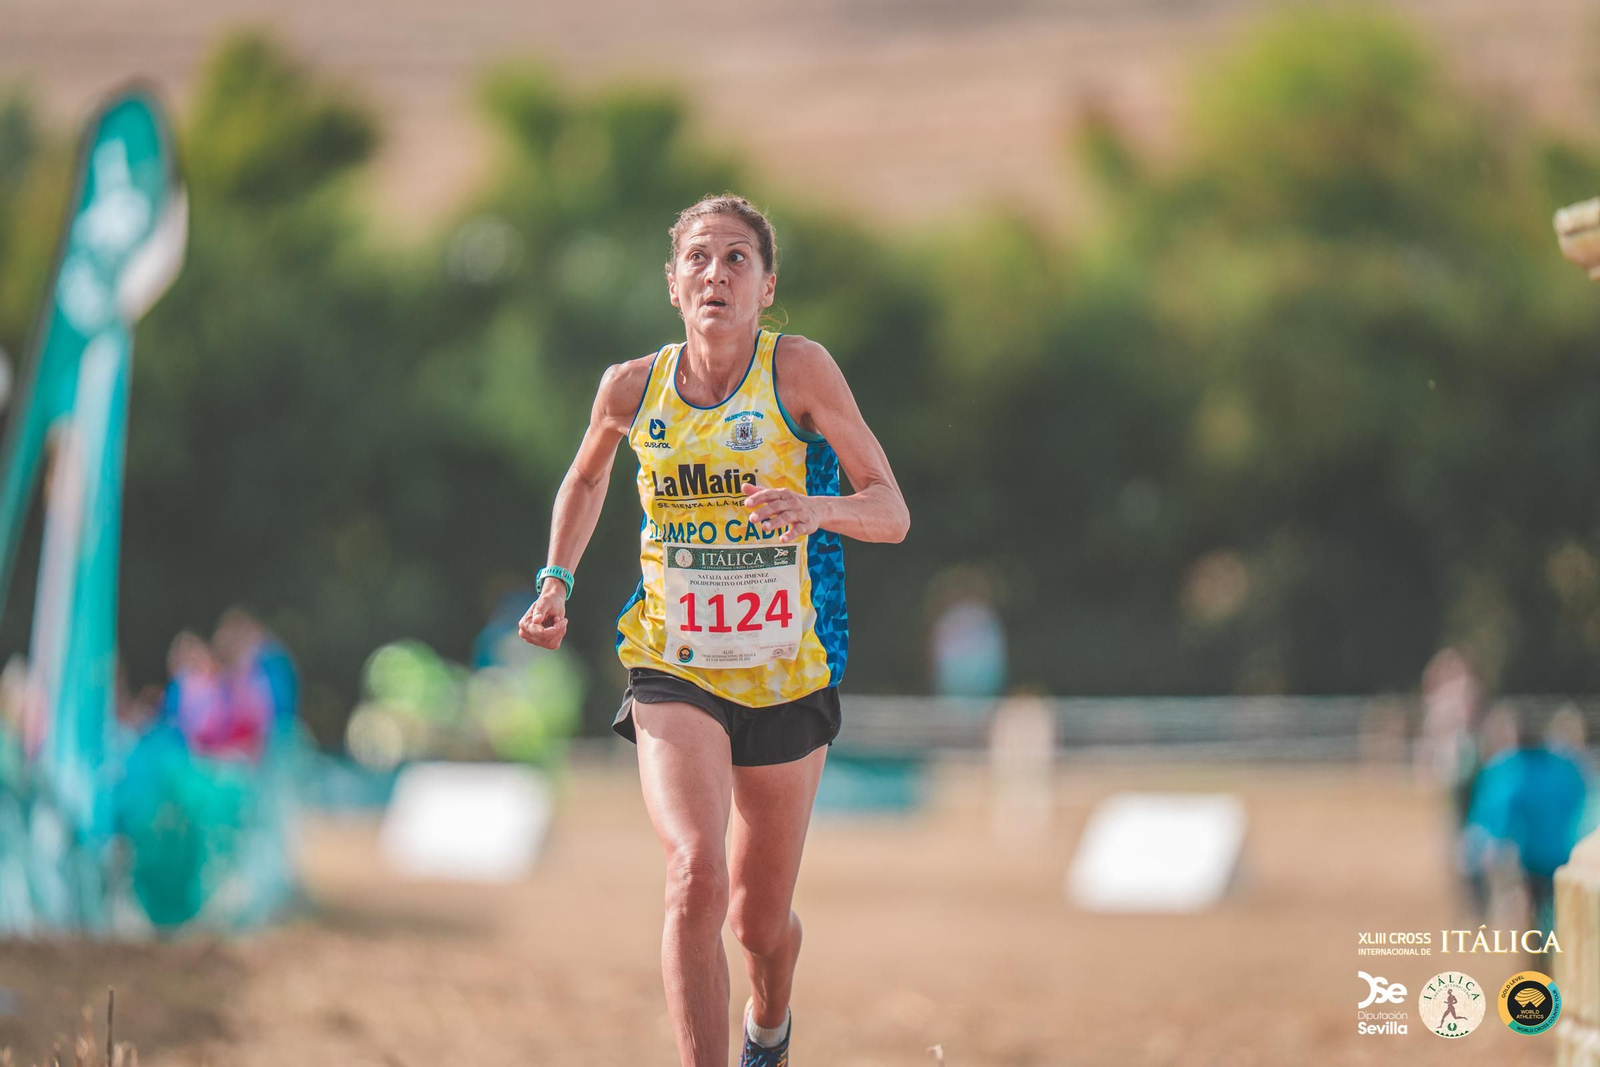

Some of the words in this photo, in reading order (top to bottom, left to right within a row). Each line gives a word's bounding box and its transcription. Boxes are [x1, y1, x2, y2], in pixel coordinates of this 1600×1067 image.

[732, 499, 746, 507] ME
[701, 550, 764, 566] ITÁLICA
[690, 579, 735, 587] POLIDEPORTIVO
[679, 589, 793, 633] 1124
